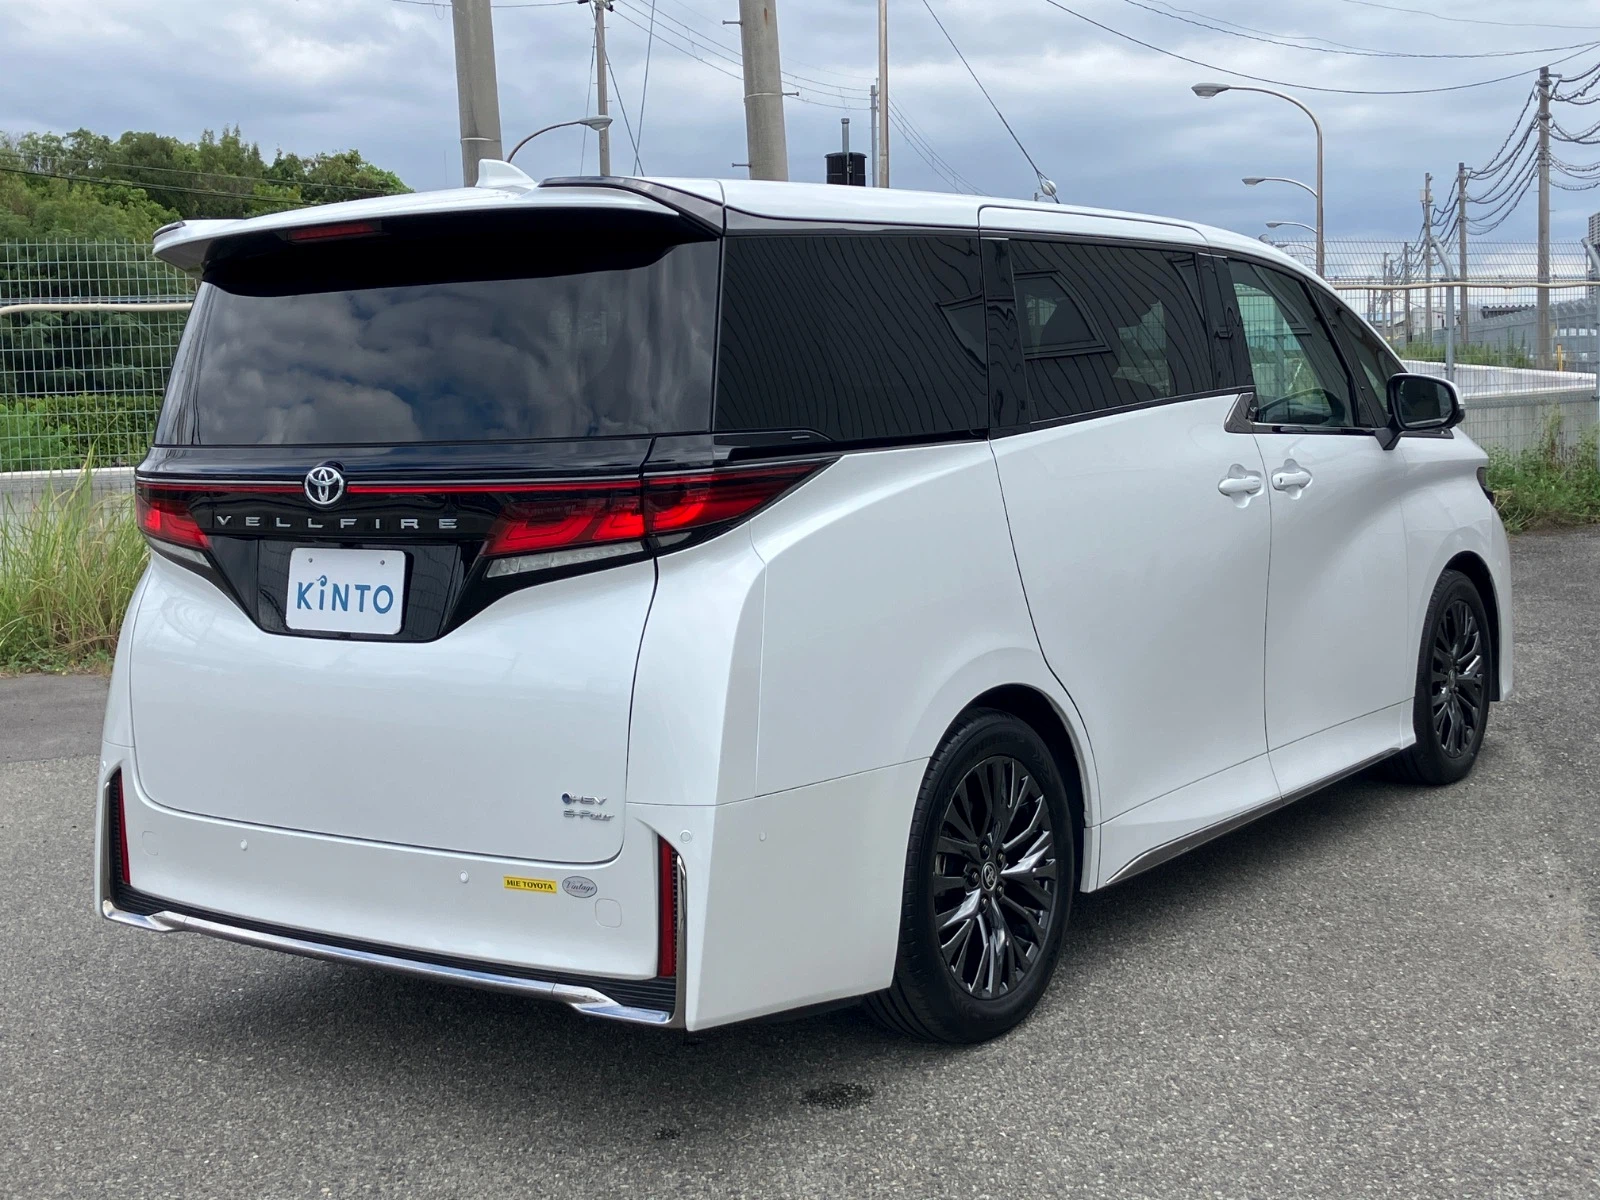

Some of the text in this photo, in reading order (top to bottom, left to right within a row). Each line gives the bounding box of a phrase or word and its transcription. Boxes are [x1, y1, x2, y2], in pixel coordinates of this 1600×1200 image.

[216, 515, 458, 529] VELLFIRE
[523, 881, 553, 890] TOYOTA
[565, 880, 594, 893] Vintage
